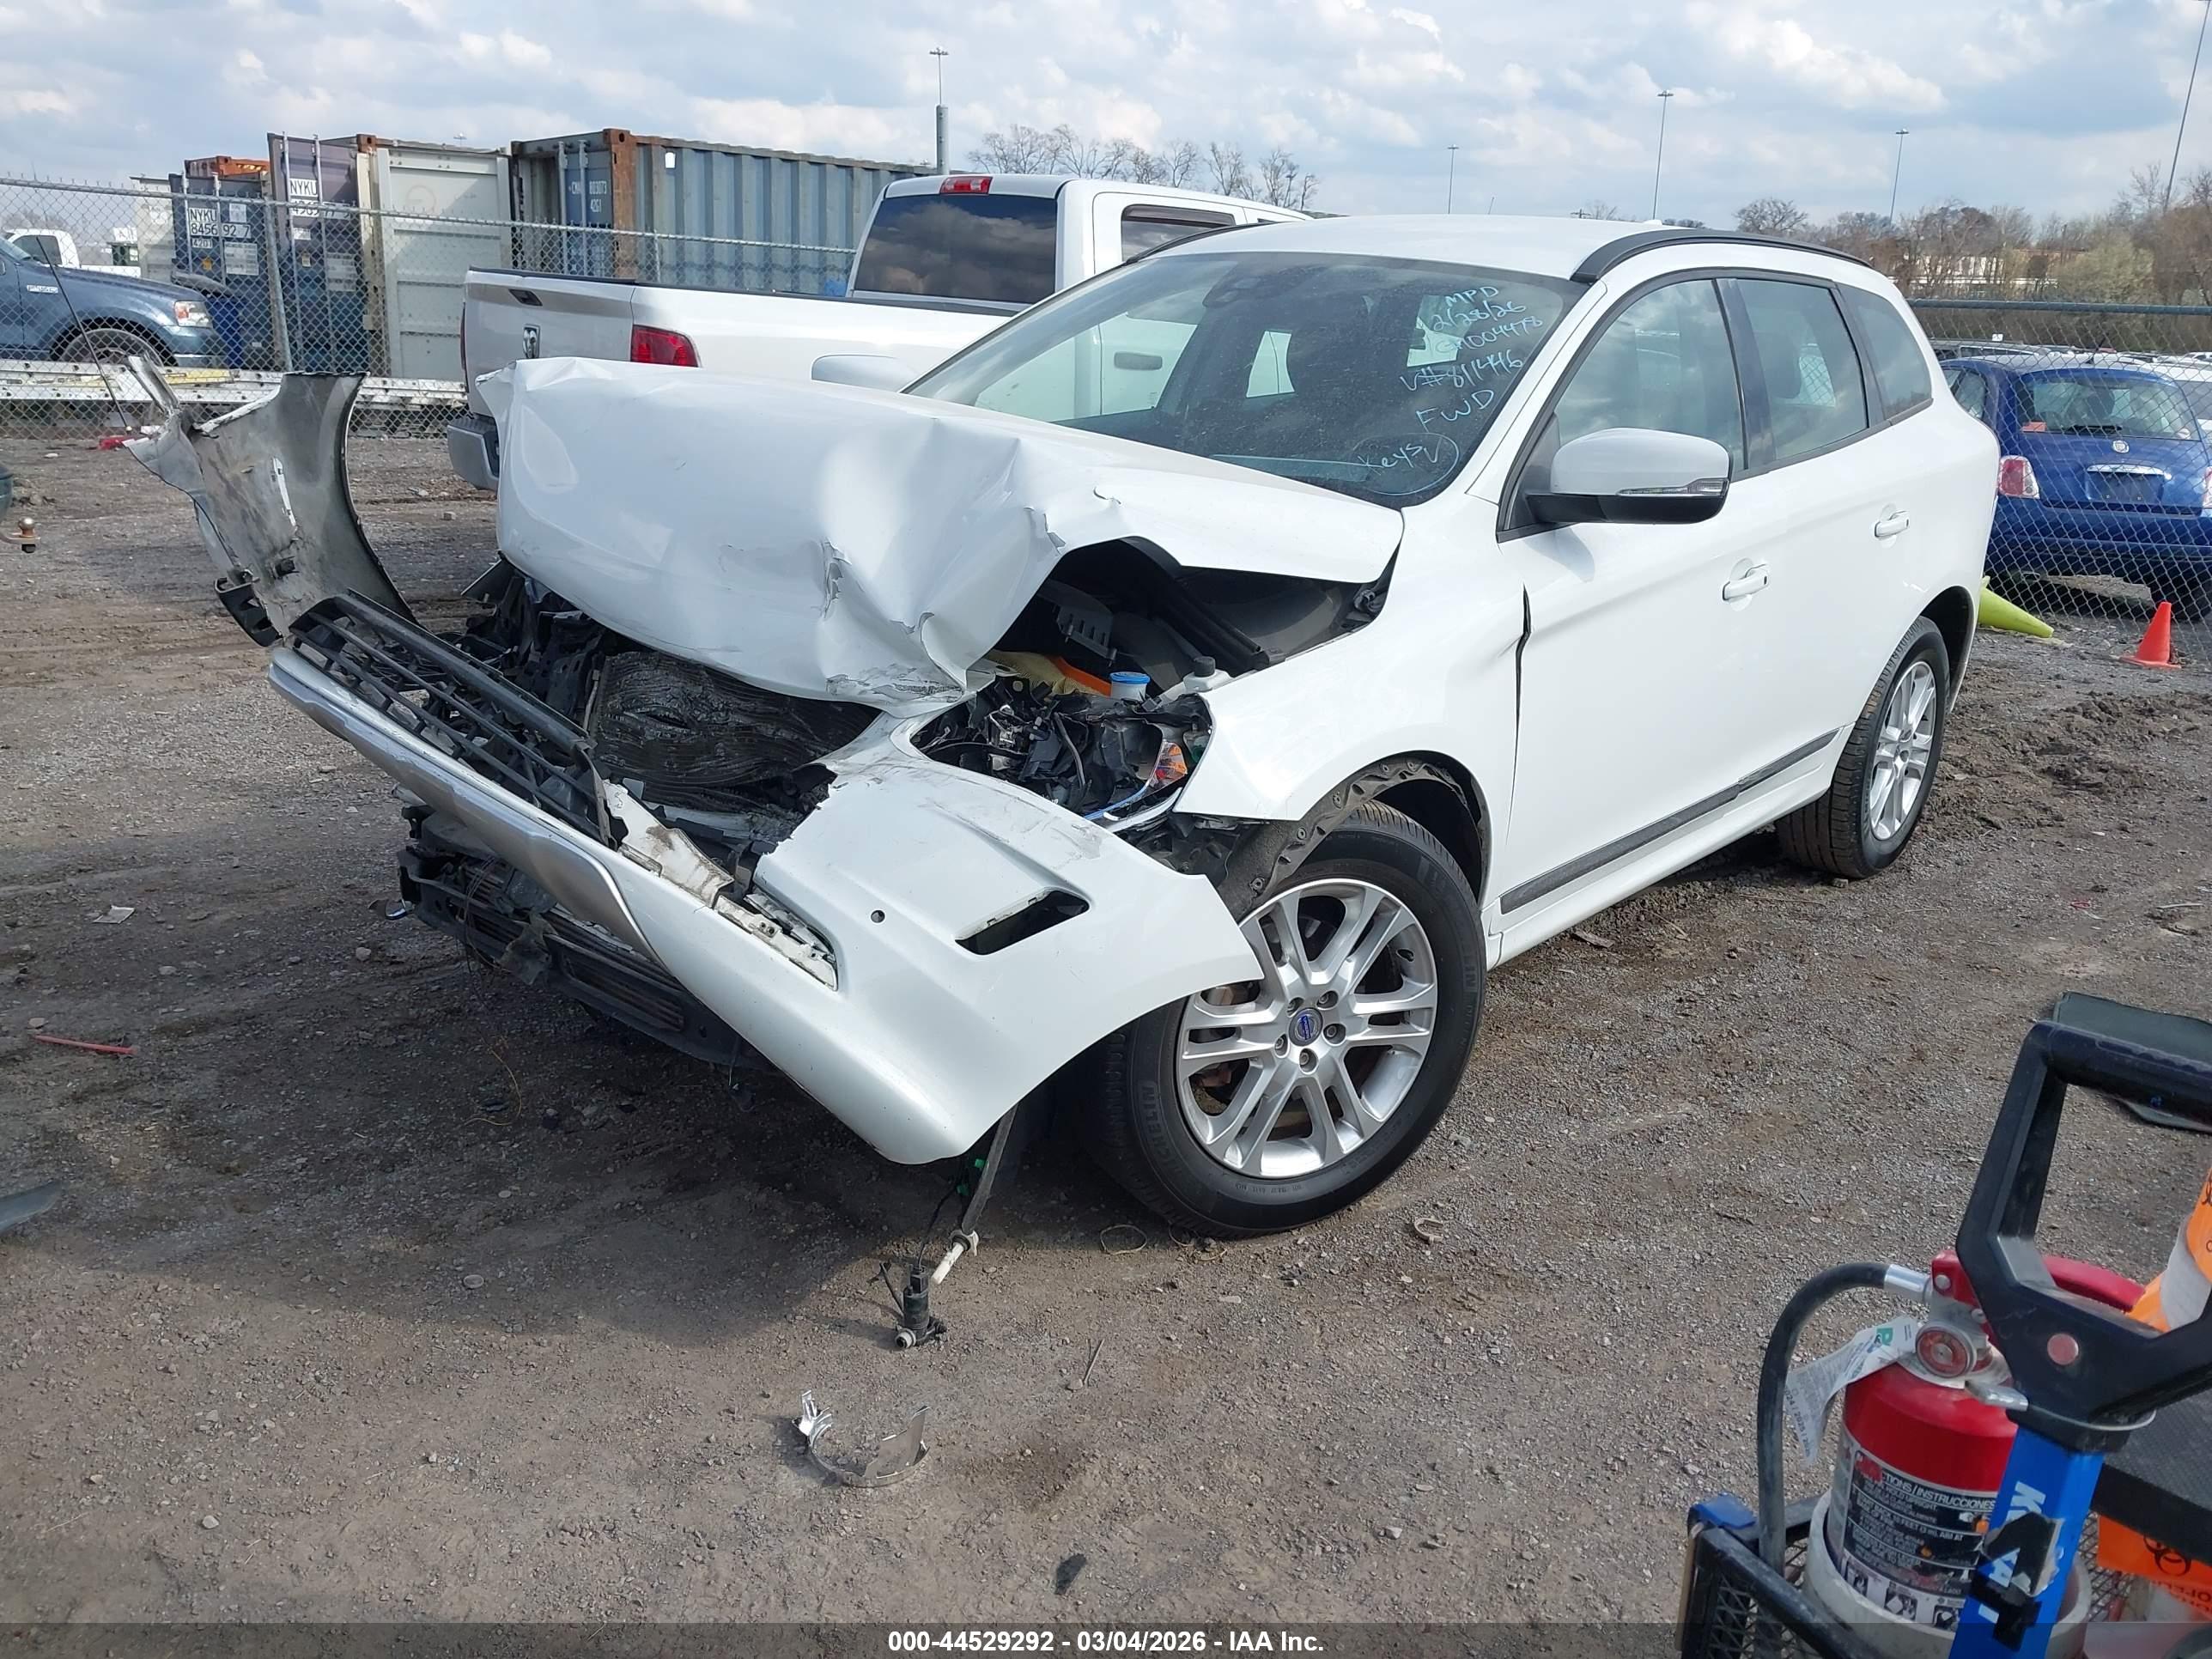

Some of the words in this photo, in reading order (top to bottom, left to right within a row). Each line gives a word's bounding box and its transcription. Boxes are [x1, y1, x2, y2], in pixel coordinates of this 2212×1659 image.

[290, 180, 317, 196] NYKU
[191, 210, 217, 222] NYKU
[191, 222, 218, 234] 8456
[223, 224, 236, 236] 92
[245, 226, 250, 237] 7
[1444, 286, 1499, 307] MPD
[1431, 300, 1527, 331] 2/28/26
[1417, 389, 1495, 433] FWD
